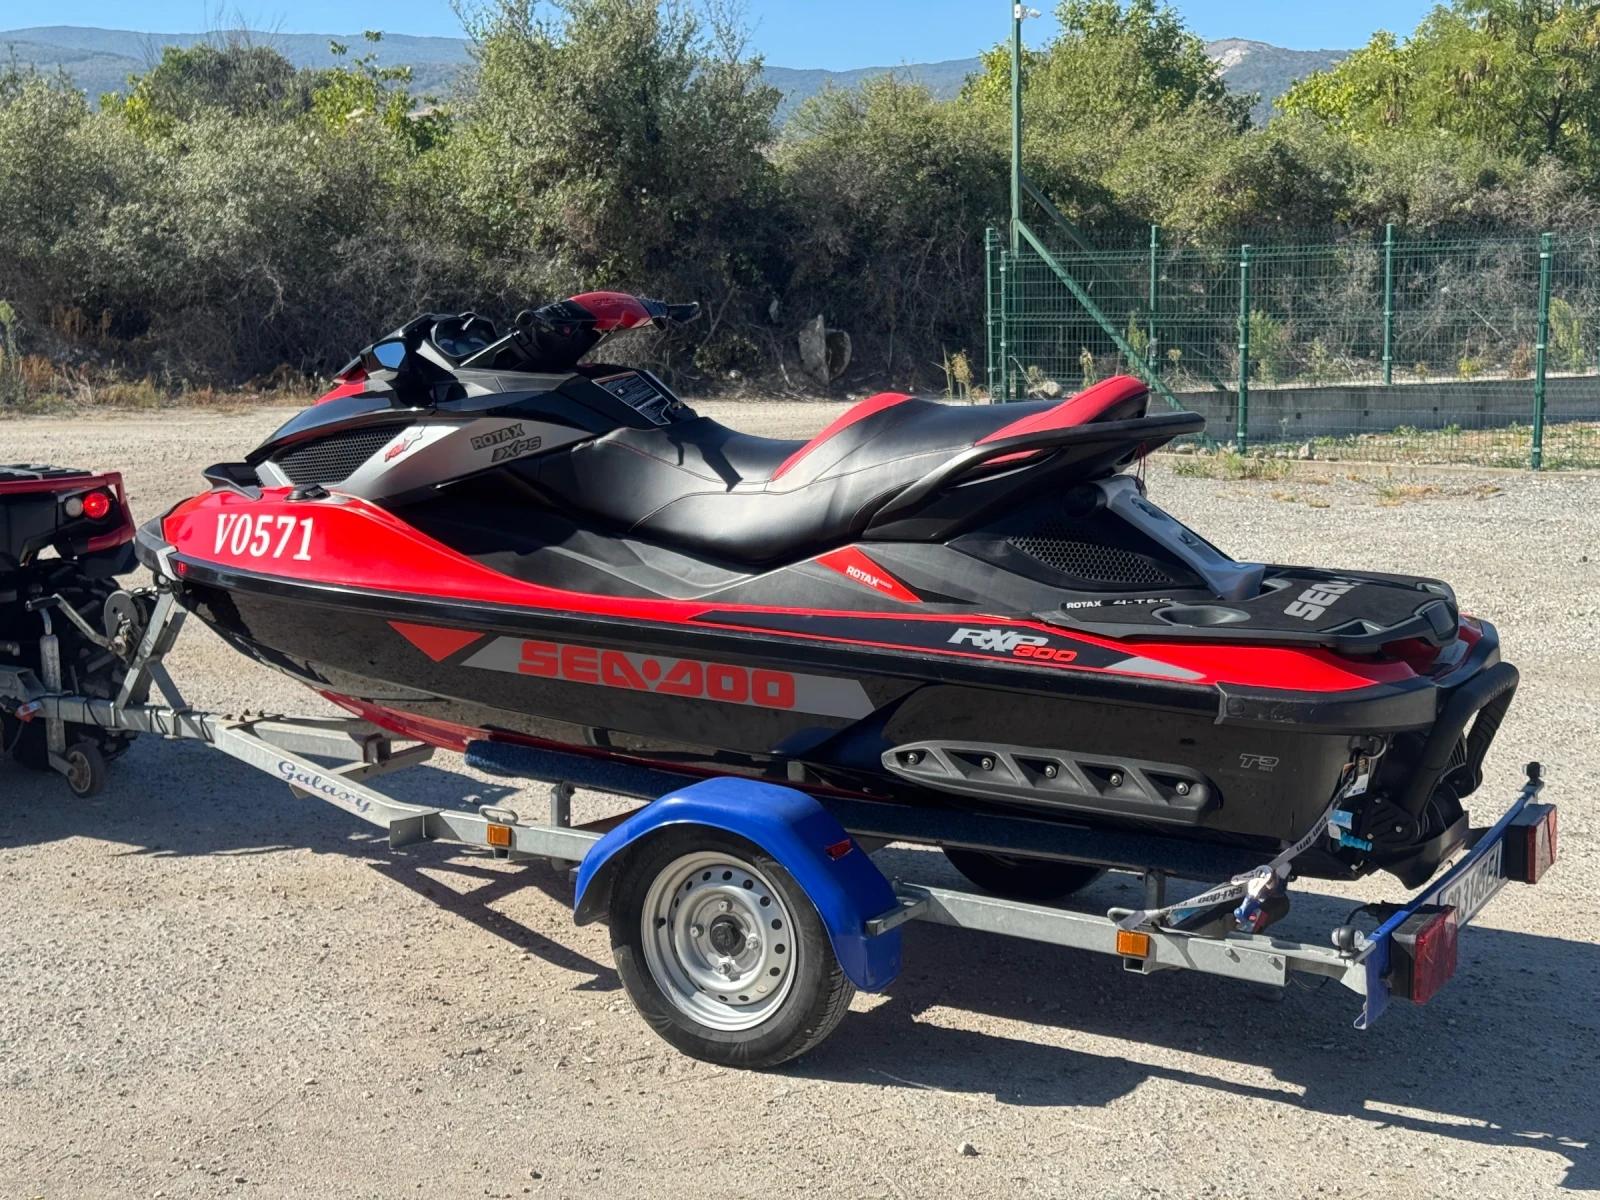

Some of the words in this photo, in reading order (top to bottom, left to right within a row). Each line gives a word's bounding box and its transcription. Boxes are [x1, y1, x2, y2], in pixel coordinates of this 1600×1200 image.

[470, 423, 525, 450] ROTAX
[498, 436, 542, 461] XPS
[846, 565, 879, 587] ROTAX
[1066, 600, 1102, 609] ROTAX
[947, 627, 1049, 652] RXP
[1012, 645, 1078, 662] 300
[1239, 753, 1280, 769] T3
[278, 761, 375, 813] Galaxy
